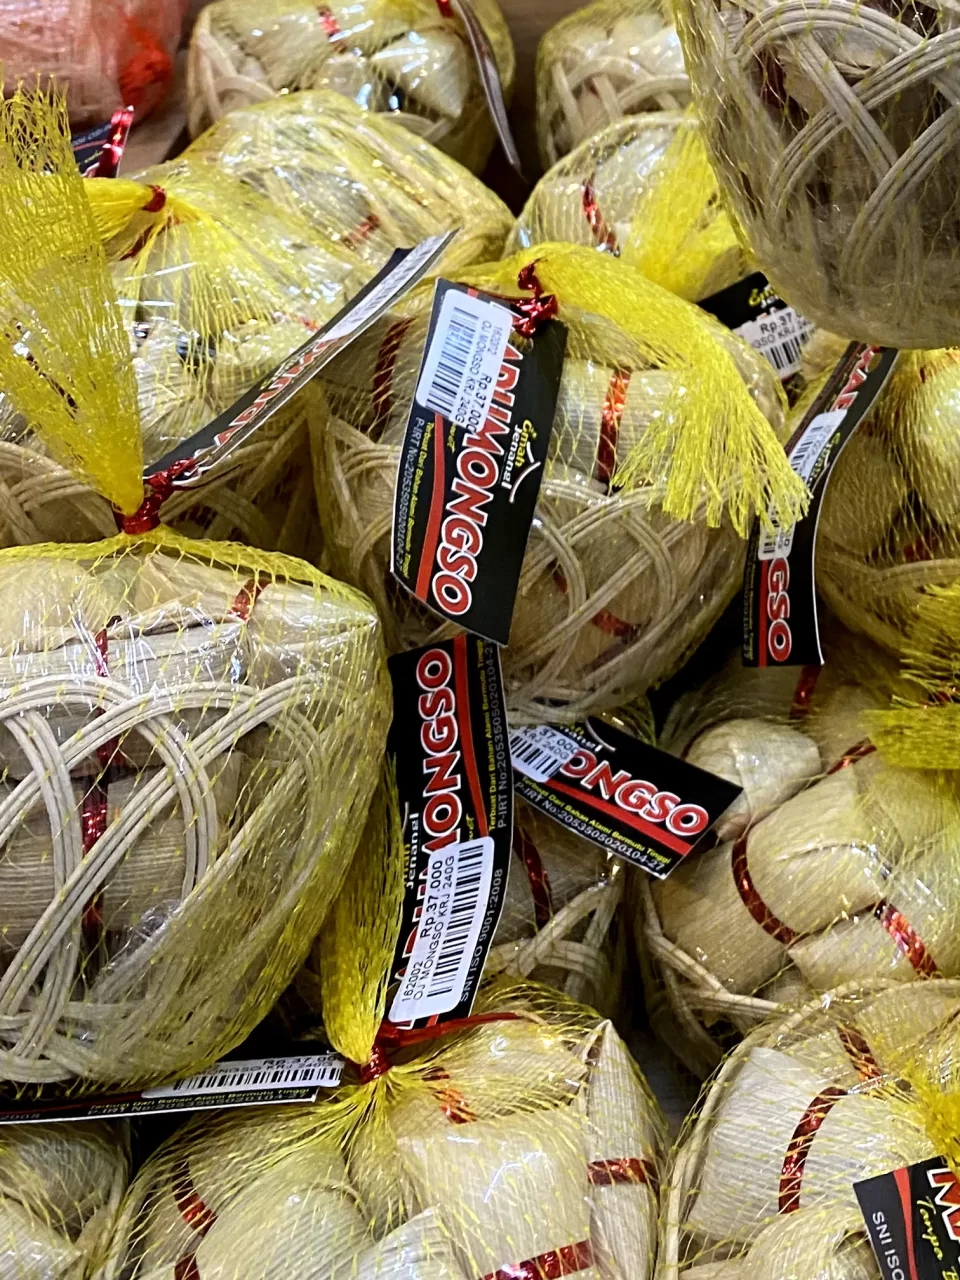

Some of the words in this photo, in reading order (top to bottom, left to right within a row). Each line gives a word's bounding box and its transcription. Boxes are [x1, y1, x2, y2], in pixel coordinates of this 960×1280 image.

[481, 320, 493, 333] OJ
[469, 334, 488, 376] MONGSO
[463, 376, 477, 397] KRJ
[454, 396, 471, 424] 240G
[410, 417, 425, 448] P-IRT
[421, 422, 435, 451] Terbuat
[417, 451, 428, 468] Dari
[412, 469, 424, 495] Bahan
[769, 557, 792, 662] GSO
[480, 671, 489, 709] Bermutu
[484, 712, 492, 738] Alami
[487, 742, 495, 770] Bahan
[543, 740, 570, 761] 240G
[560, 747, 710, 836] ONGSO
[488, 796, 496, 831] Terbuat
[498, 794, 508, 828] P-IRT
[549, 793, 565, 808] Dari
[564, 804, 590, 823] Bahan
[588, 818, 613, 835] Alami
[611, 829, 646, 852] Bermutu
[645, 847, 671, 866] Tinggi
[443, 854, 454, 888] 240G
[438, 892, 450, 917] KRJ
[468, 944, 483, 972] ISO
[478, 868, 504, 942] 9001:2008
[401, 961, 423, 1003] 162002
[420, 860, 443, 939] Rp.37.000
[420, 921, 444, 980] MONGSO
[414, 982, 426, 1001] OJ
[871, 1210, 892, 1246] SNI
[915, 1194, 944, 1261] Tanpa
